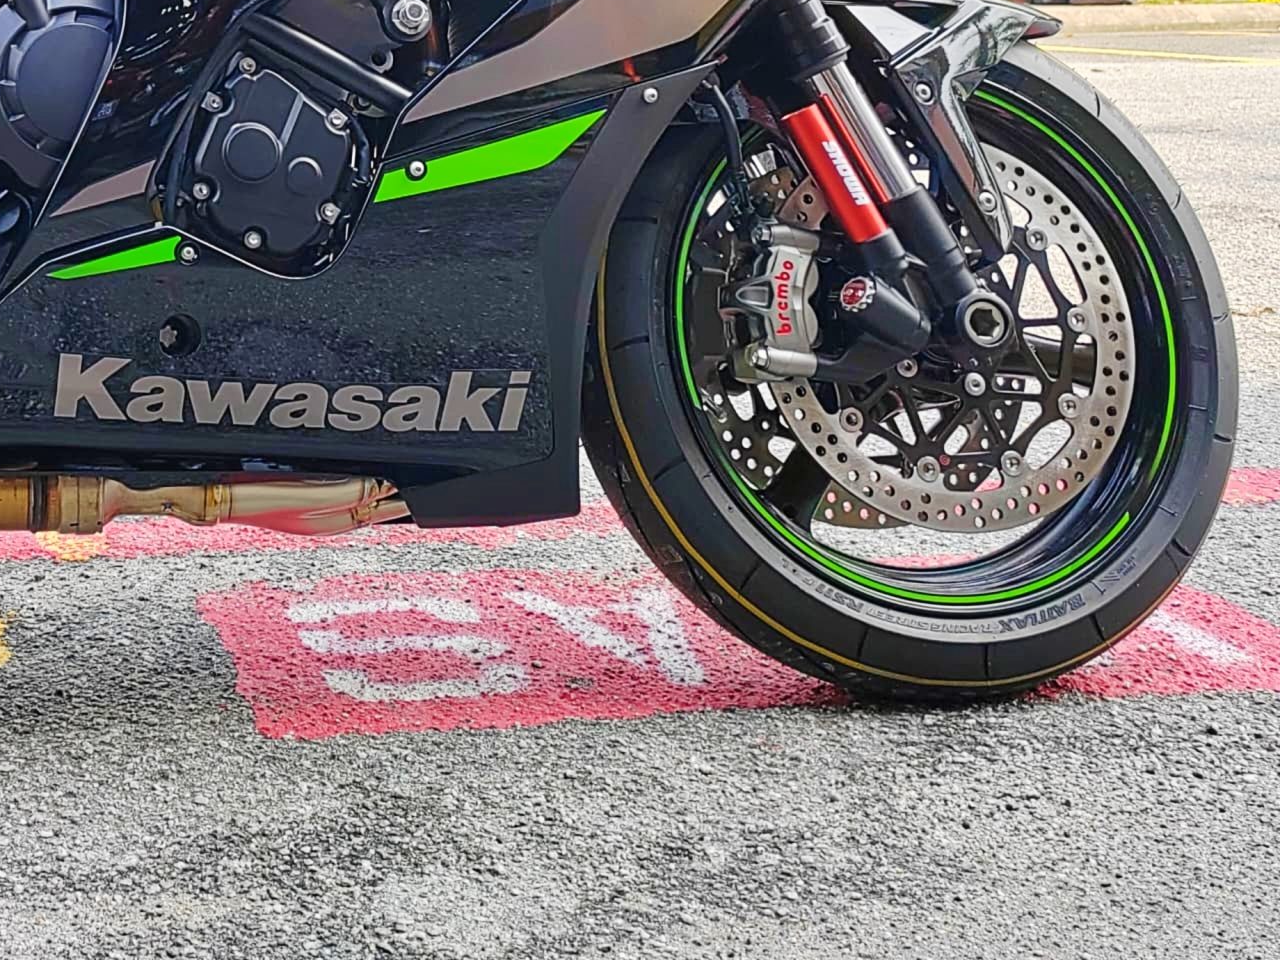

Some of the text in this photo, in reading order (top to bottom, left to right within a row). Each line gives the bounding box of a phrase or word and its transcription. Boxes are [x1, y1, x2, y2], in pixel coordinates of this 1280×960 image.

[821, 140, 871, 206] SHOWA
[774, 260, 794, 336] brembo
[53, 353, 532, 432] Kawasaki
